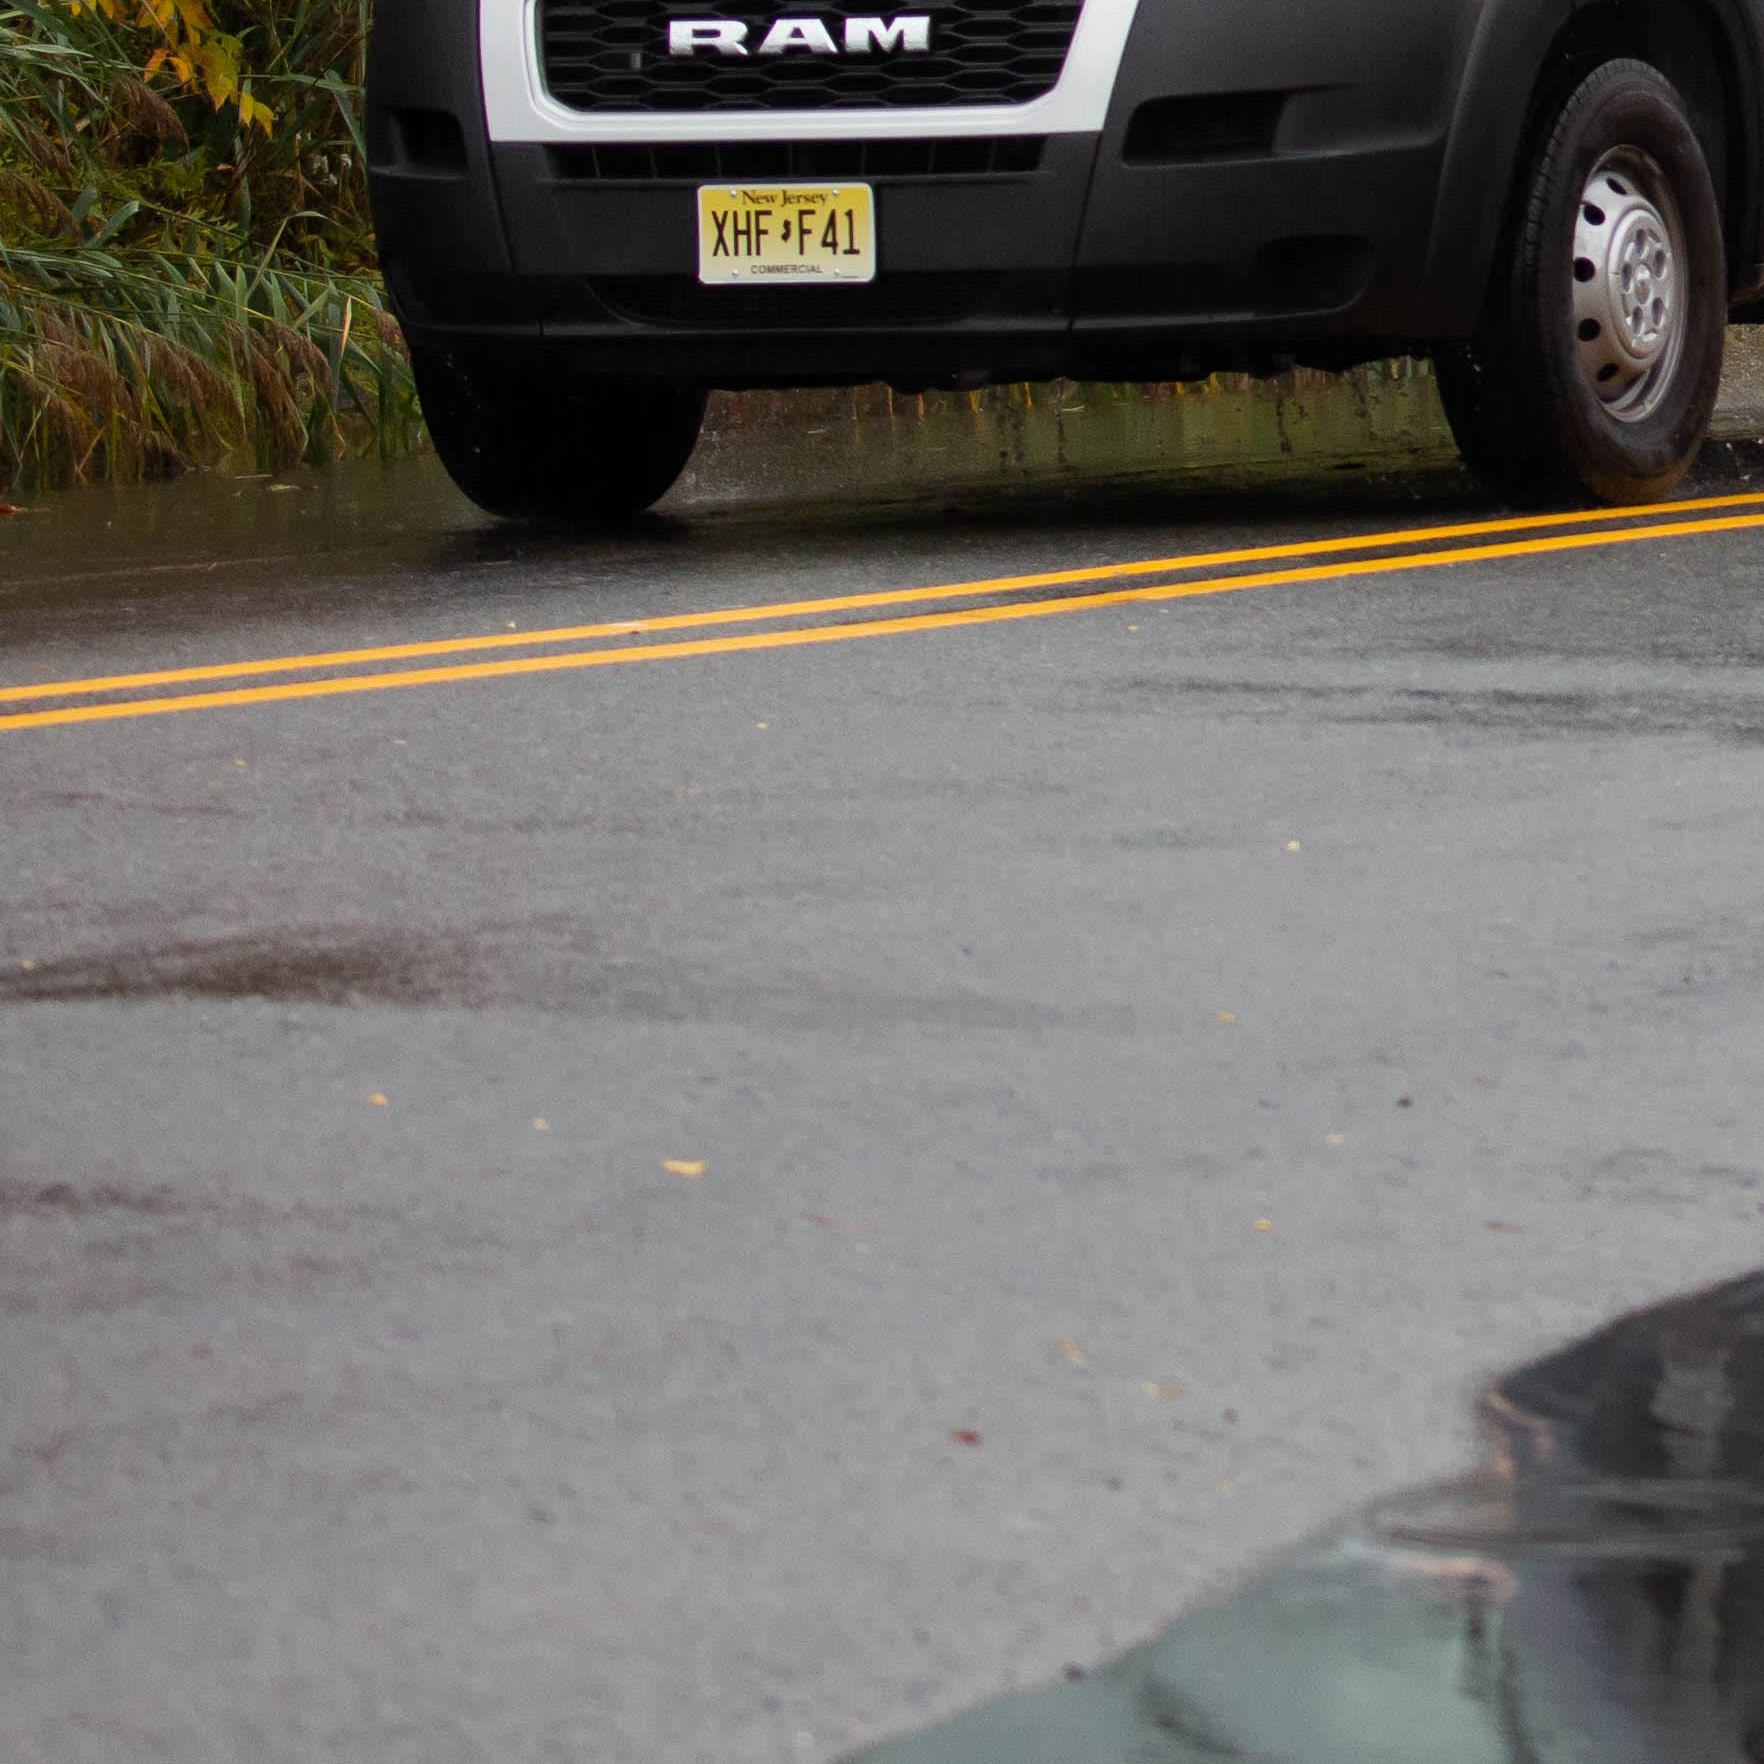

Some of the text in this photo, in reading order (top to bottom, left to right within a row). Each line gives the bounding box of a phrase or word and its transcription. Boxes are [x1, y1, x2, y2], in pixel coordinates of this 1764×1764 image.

[668, 16, 931, 56] RAM
[742, 189, 829, 207] New Jersey
[711, 208, 861, 257] XHF F41
[751, 264, 824, 275] COMMERCIAL
